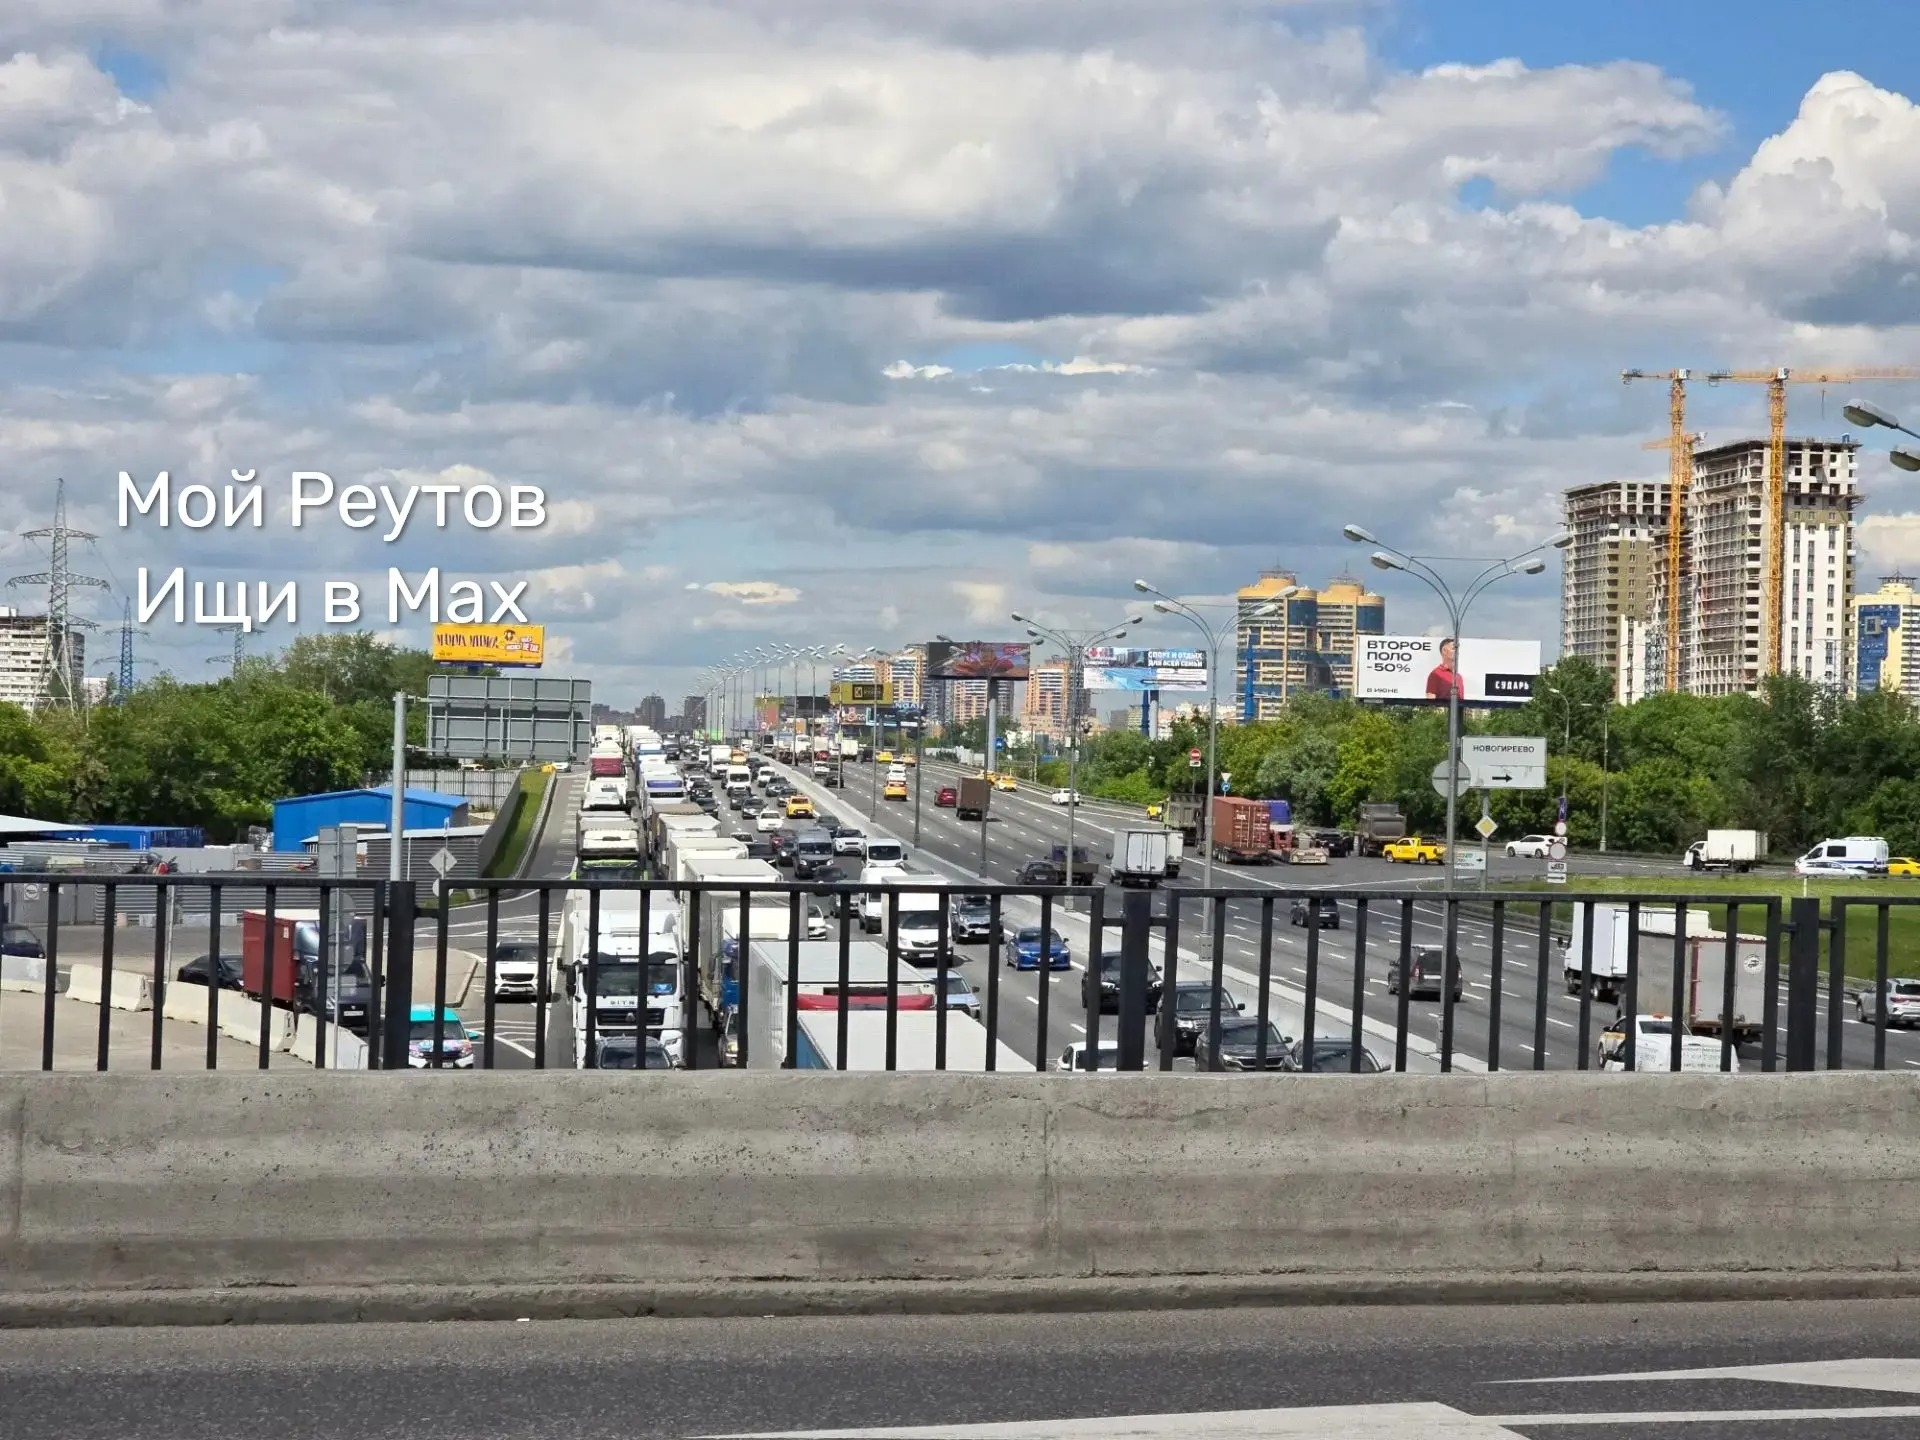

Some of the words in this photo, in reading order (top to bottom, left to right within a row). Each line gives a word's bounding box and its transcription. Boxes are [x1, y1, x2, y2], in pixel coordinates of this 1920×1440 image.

[1367, 640, 1432, 651] ВТОРОЕ
[1148, 651, 1170, 659] СПОРТ
[1367, 652, 1412, 661] ПОЛО
[1367, 663, 1411, 673] -50%
[1495, 680, 1529, 690] СУДАРЬ
[1473, 744, 1535, 753] НОВОГИРЕЕВО
